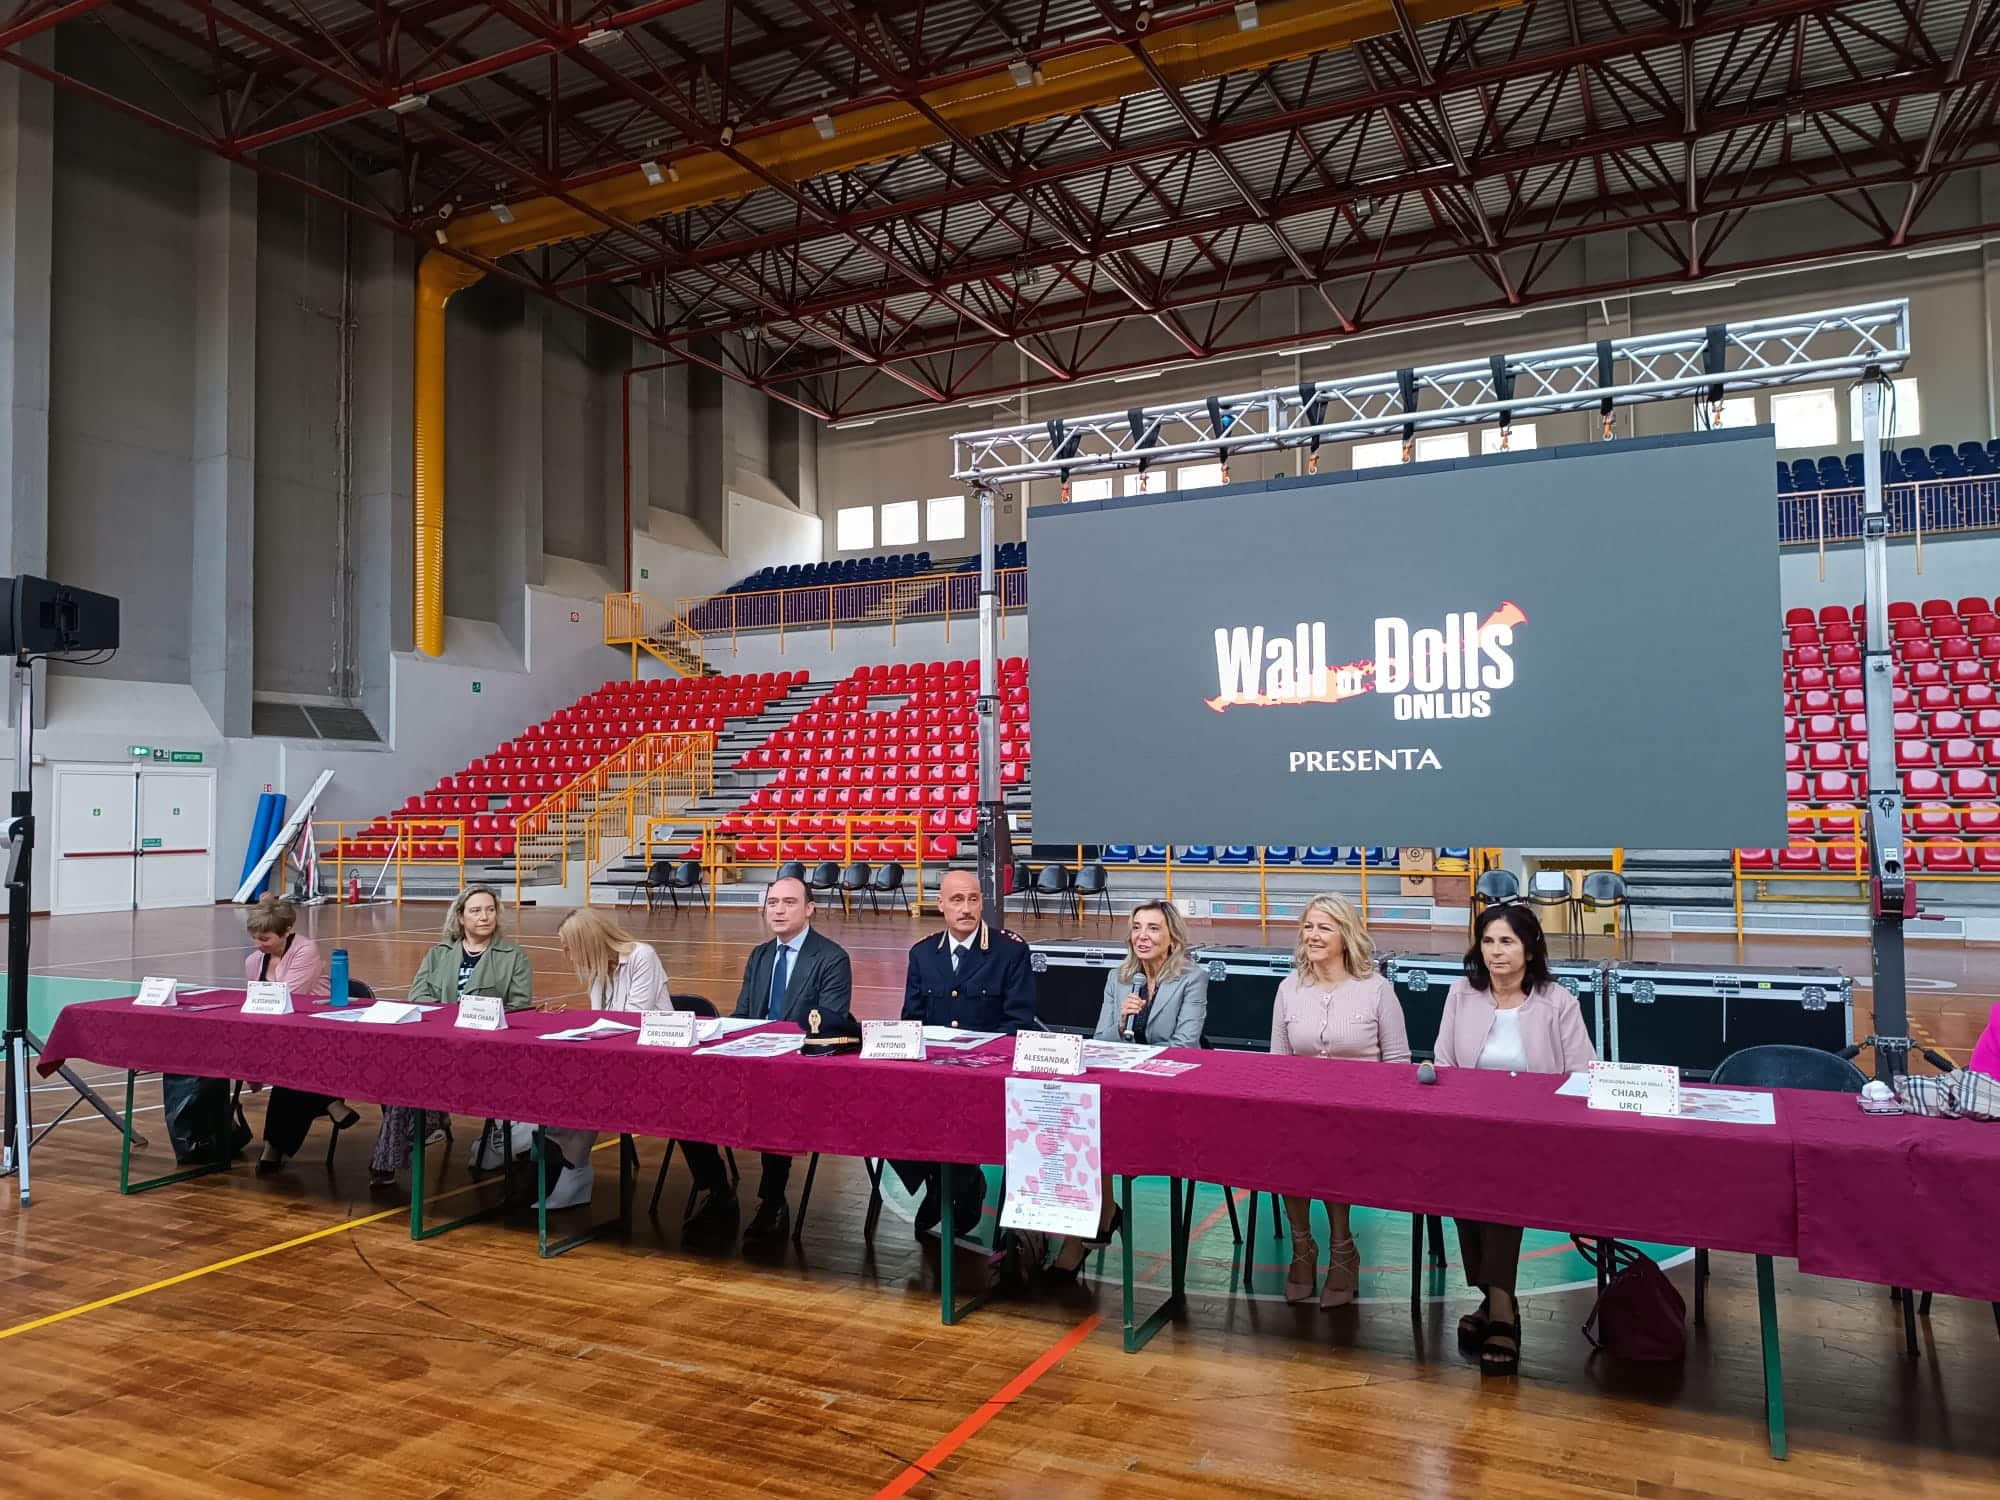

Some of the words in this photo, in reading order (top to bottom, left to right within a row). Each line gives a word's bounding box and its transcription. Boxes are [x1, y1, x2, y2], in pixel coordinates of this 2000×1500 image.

[1214, 622, 1326, 701] Wall
[1374, 612, 1514, 694] Dolls
[1393, 691, 1491, 721] ONLUS
[1289, 747, 1443, 773] PRESENTA
[875, 1041, 907, 1049] ANTONIO
[1023, 1053, 1070, 1065] ALESSANDRA
[1611, 1089, 1648, 1098] CHIARA
[1619, 1102, 1642, 1110] URCI
